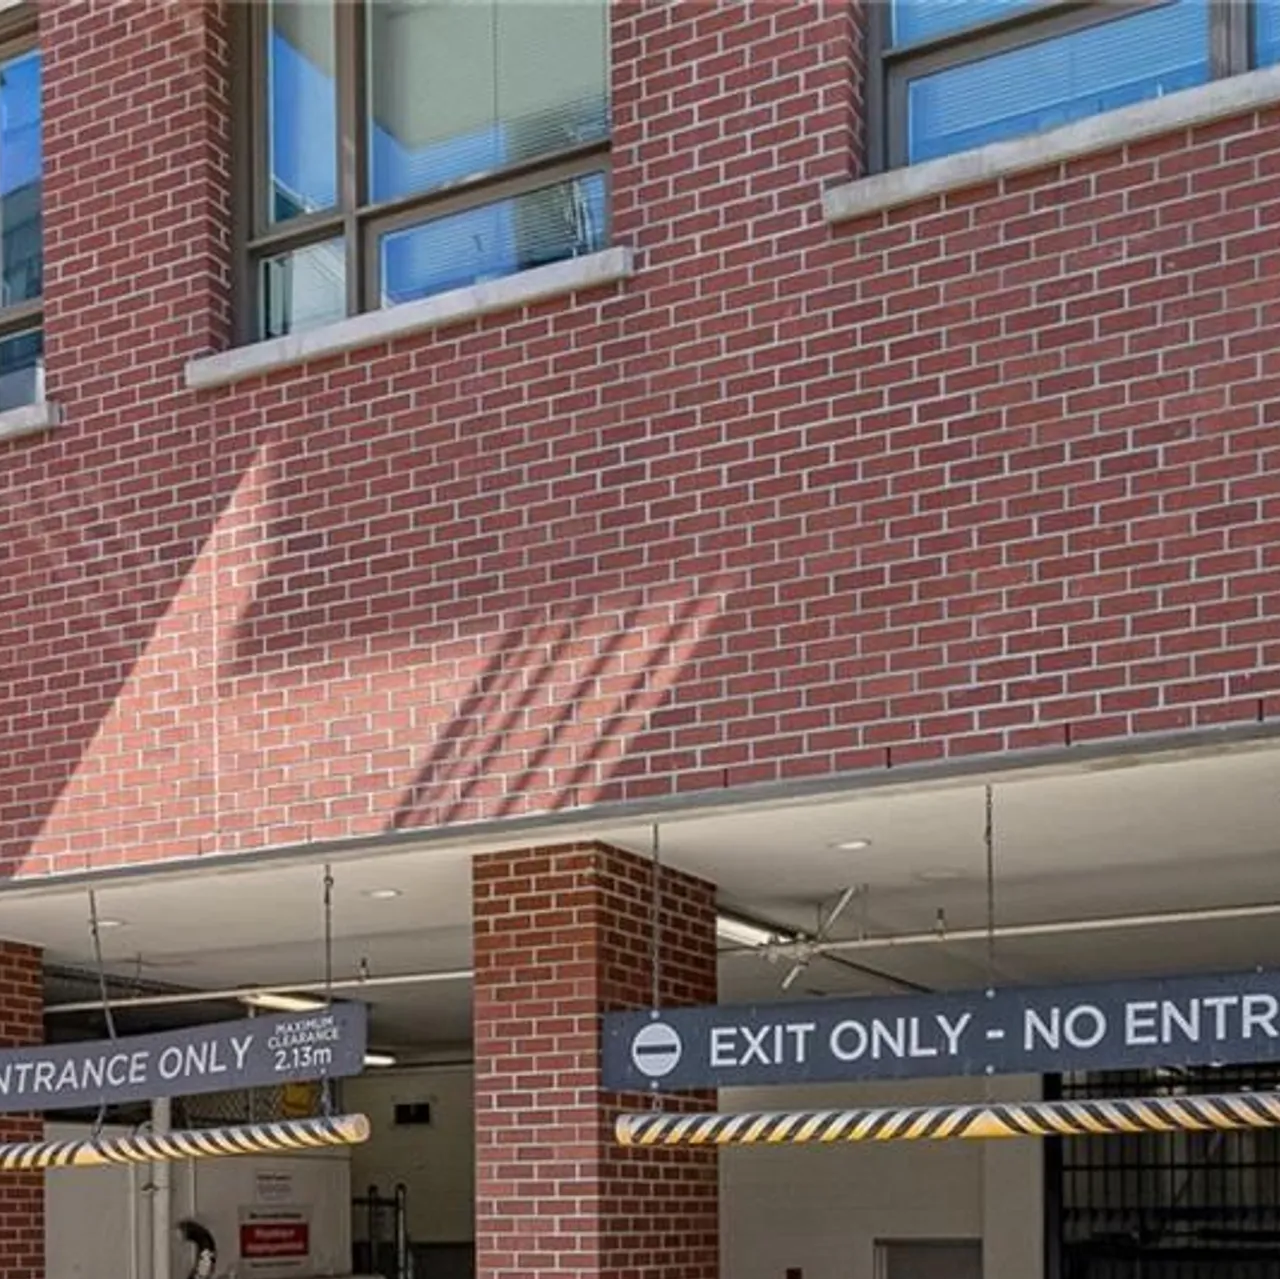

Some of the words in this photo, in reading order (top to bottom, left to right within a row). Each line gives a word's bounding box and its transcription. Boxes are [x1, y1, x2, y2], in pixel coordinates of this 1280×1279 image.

[273, 1015, 335, 1035] MAXIMUM
[708, 1021, 816, 1067] EXIT
[829, 1012, 972, 1062] ONLY
[1023, 1004, 1107, 1052] NO
[266, 1027, 341, 1050] CLEARANCE
[157, 1034, 253, 1080] ONLY
[274, 1046, 333, 1072] 2.13m
